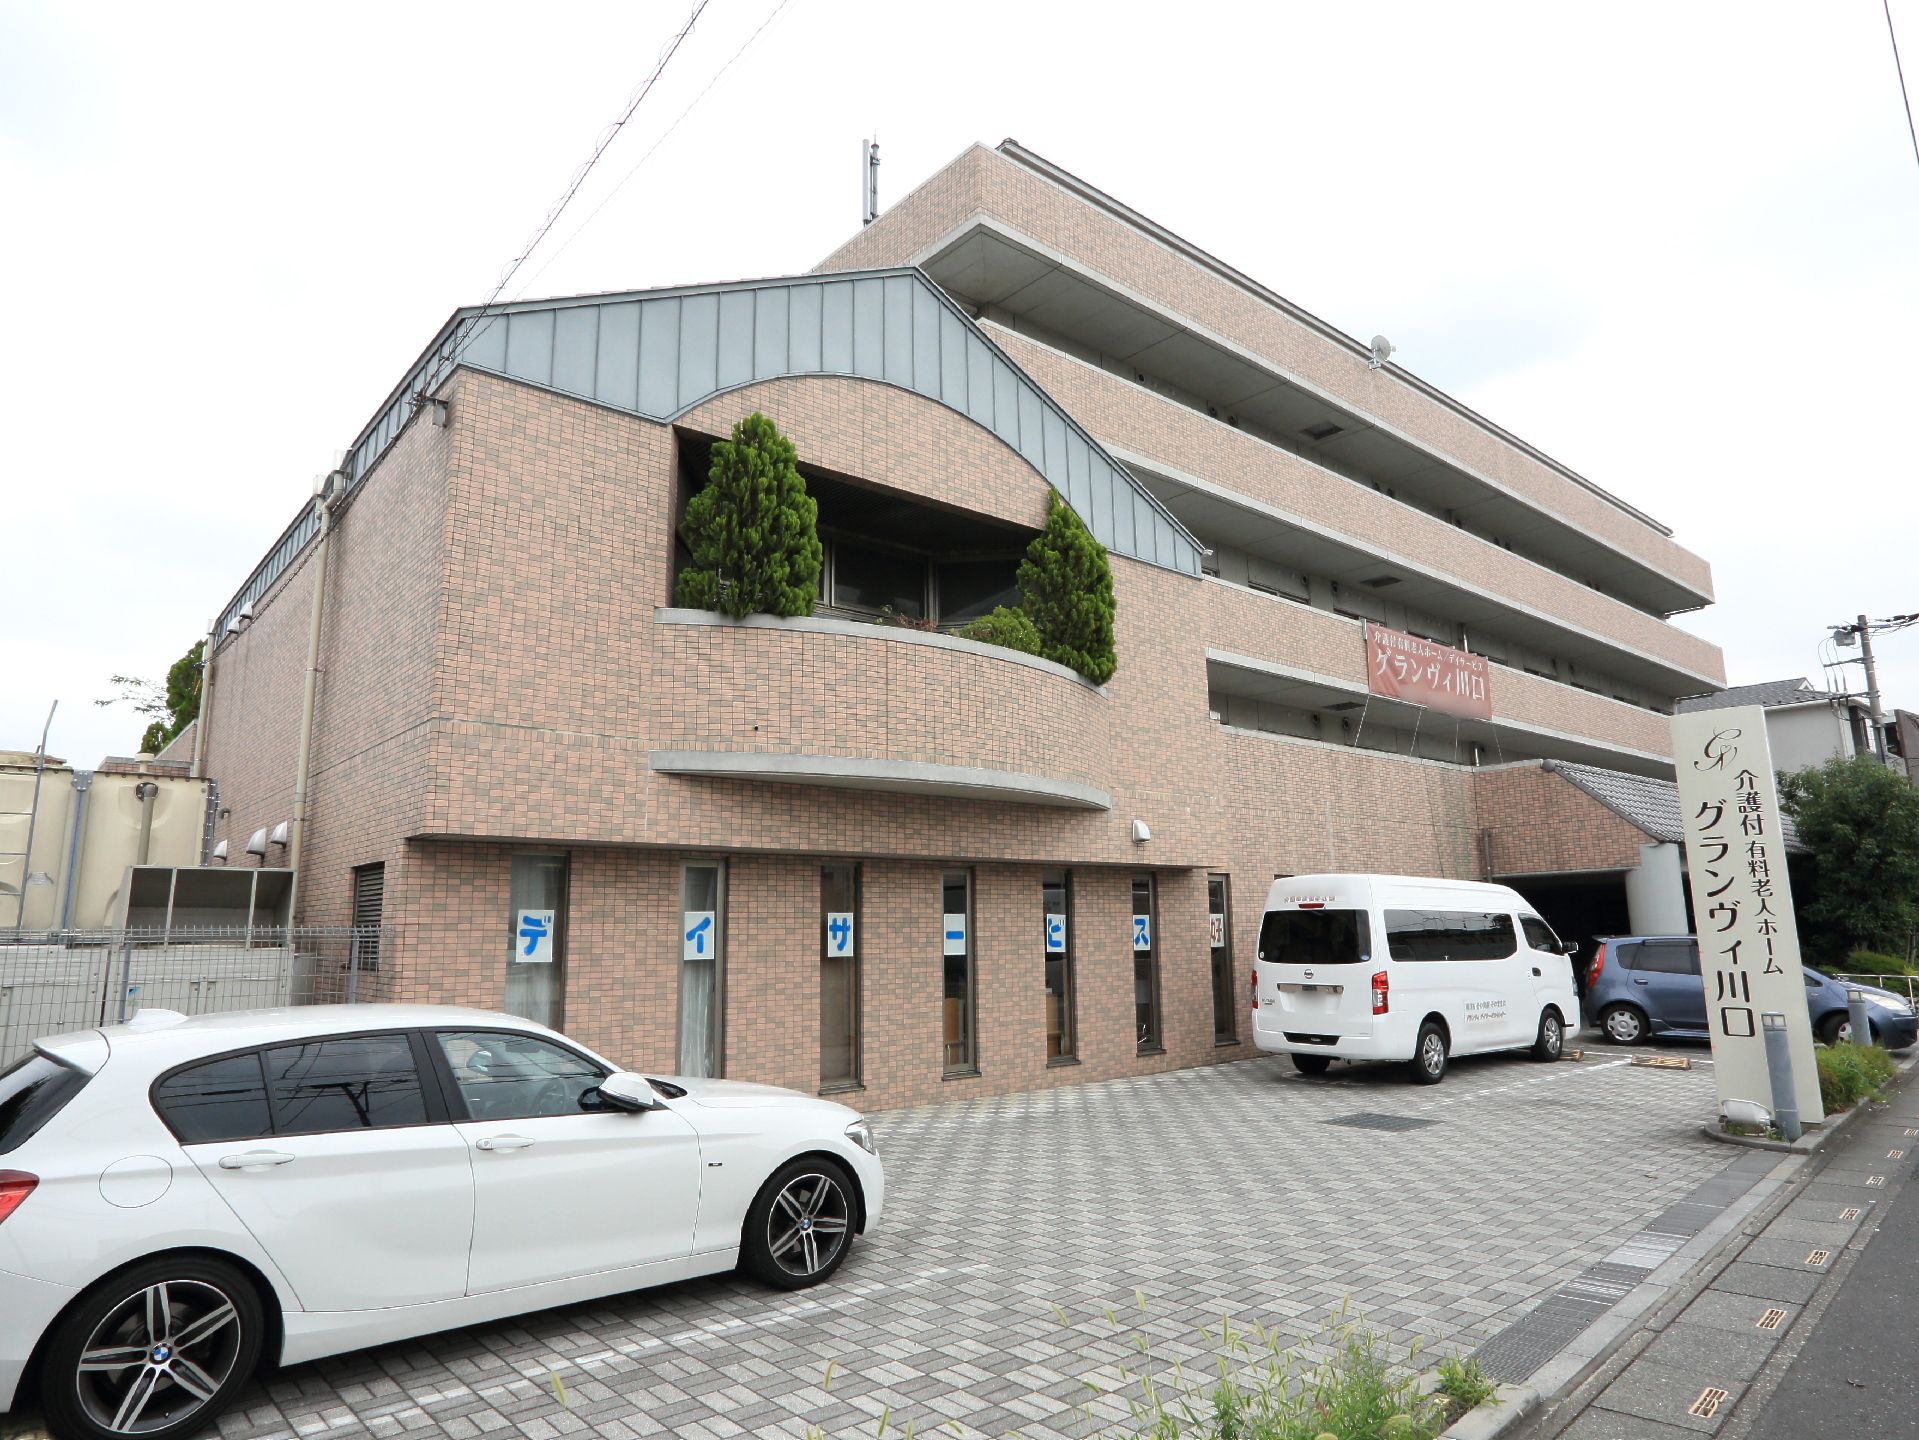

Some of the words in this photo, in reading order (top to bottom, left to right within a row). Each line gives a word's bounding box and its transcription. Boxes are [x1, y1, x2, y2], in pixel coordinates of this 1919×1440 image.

[1376, 648, 1485, 701] グランヴィ川口
[1695, 799, 1756, 1038] グランヴィ川口
